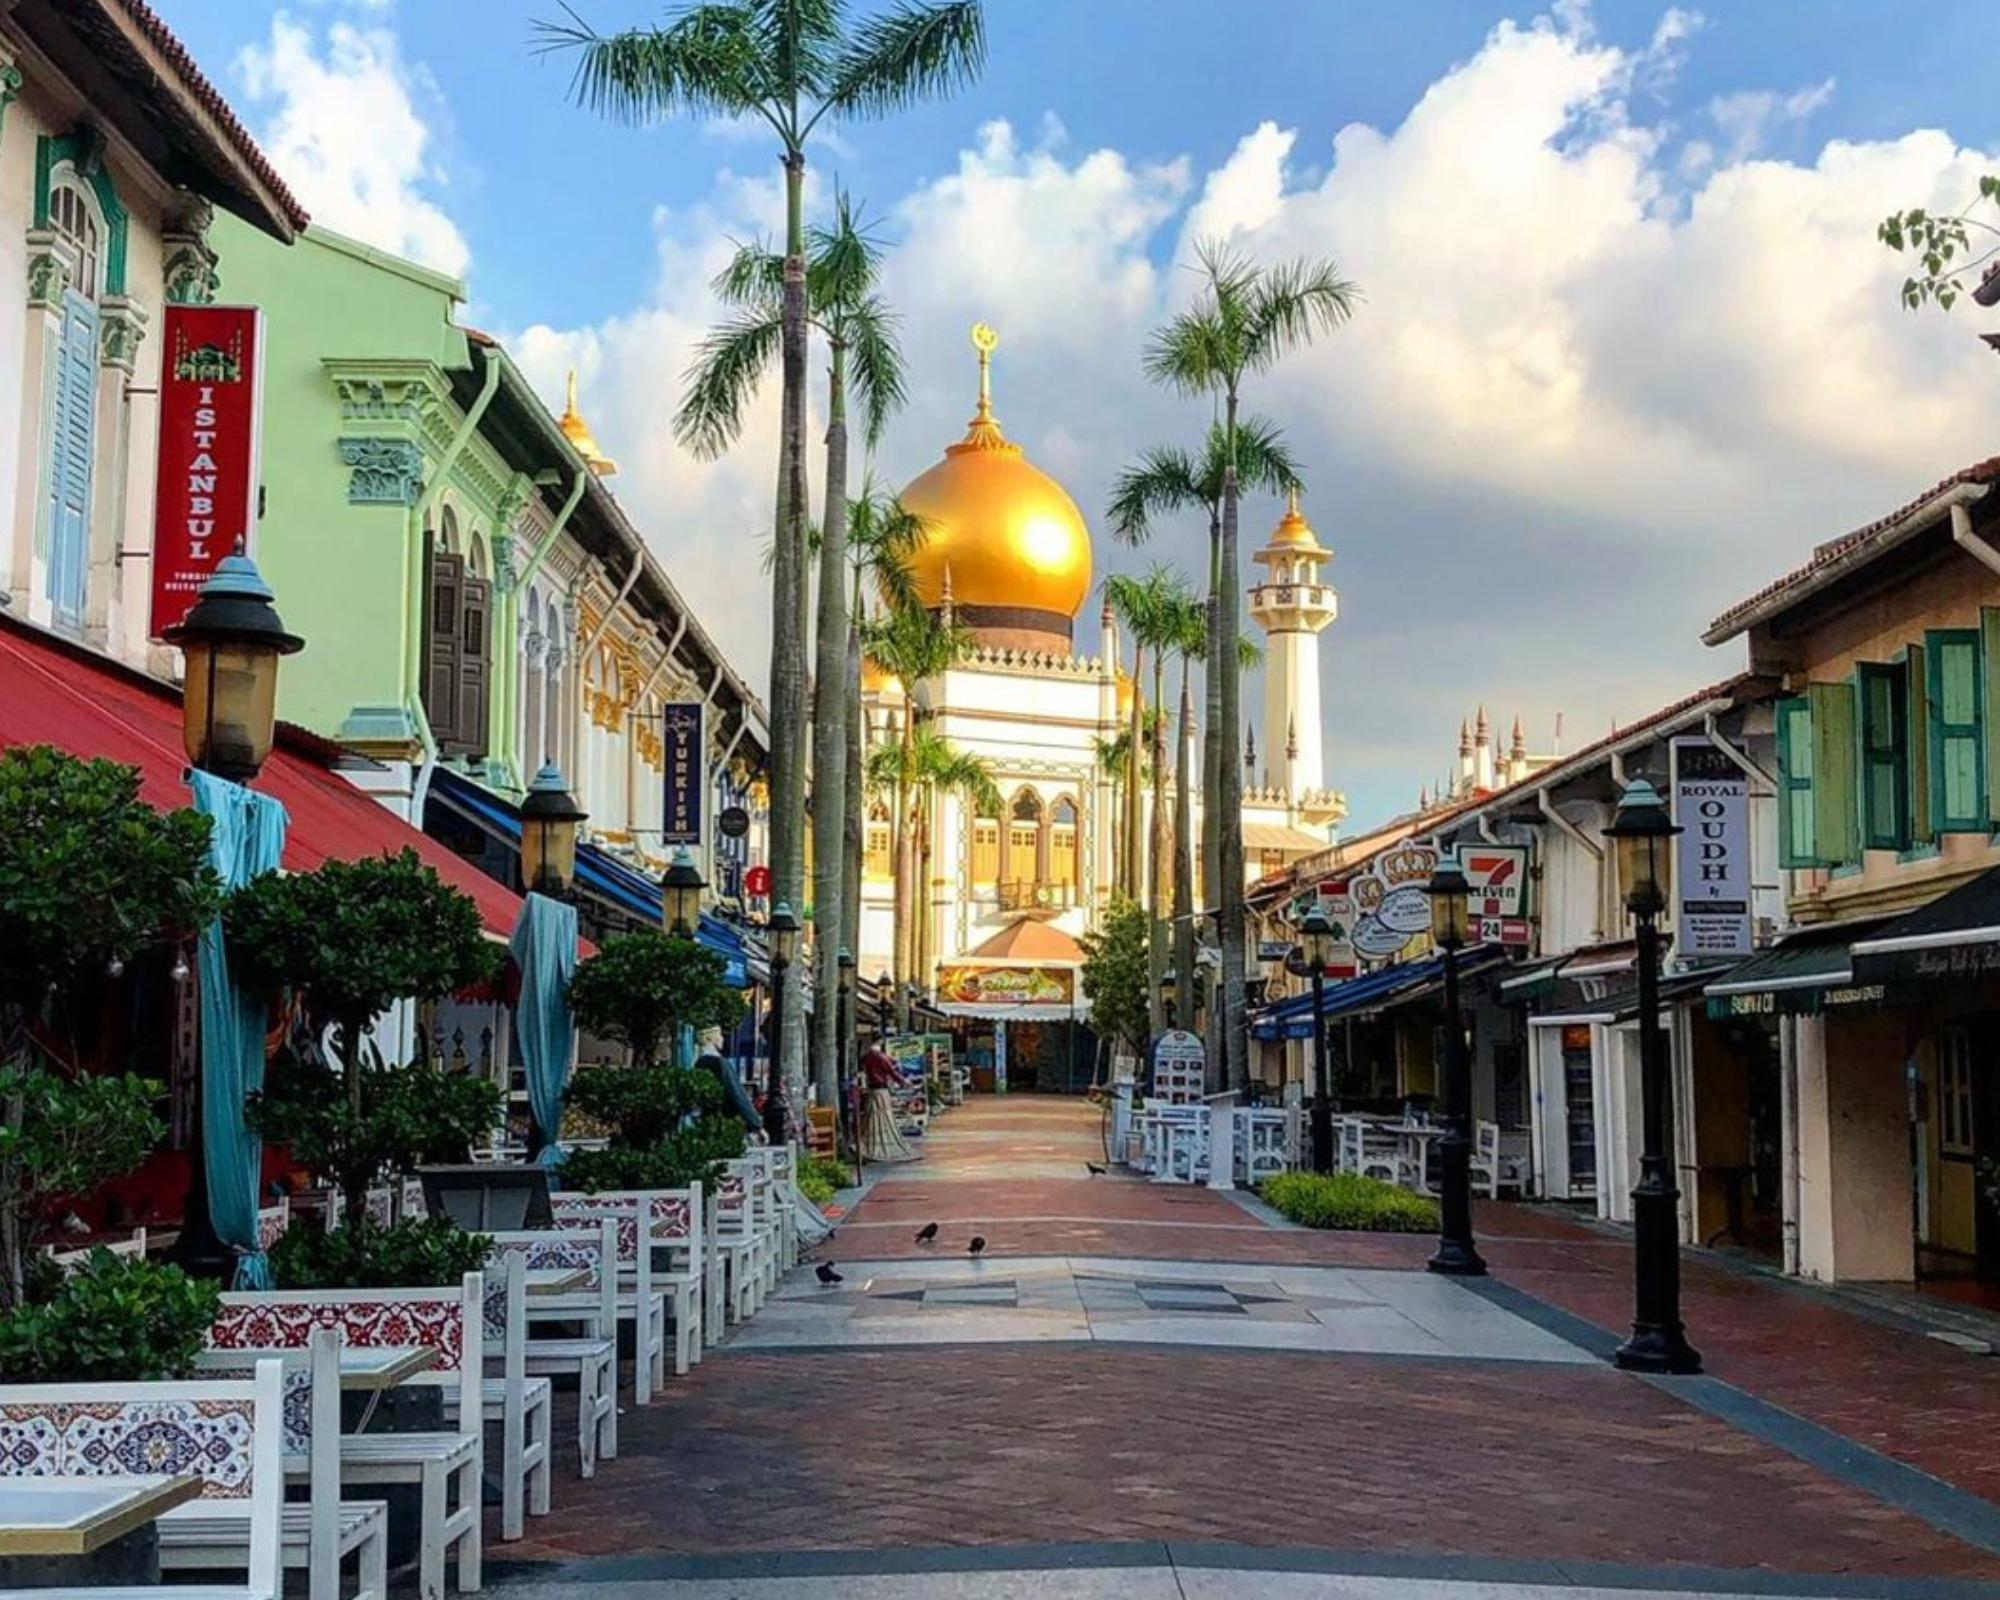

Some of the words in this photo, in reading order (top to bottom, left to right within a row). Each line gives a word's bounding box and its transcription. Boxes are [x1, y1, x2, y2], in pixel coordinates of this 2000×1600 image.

[188, 387, 218, 559] ISTANBUL
[675, 732, 688, 831] TURKISH
[1681, 786, 1743, 797] ROYAL
[1699, 801, 1728, 881] OUDH
[1482, 921, 1499, 937] 24
